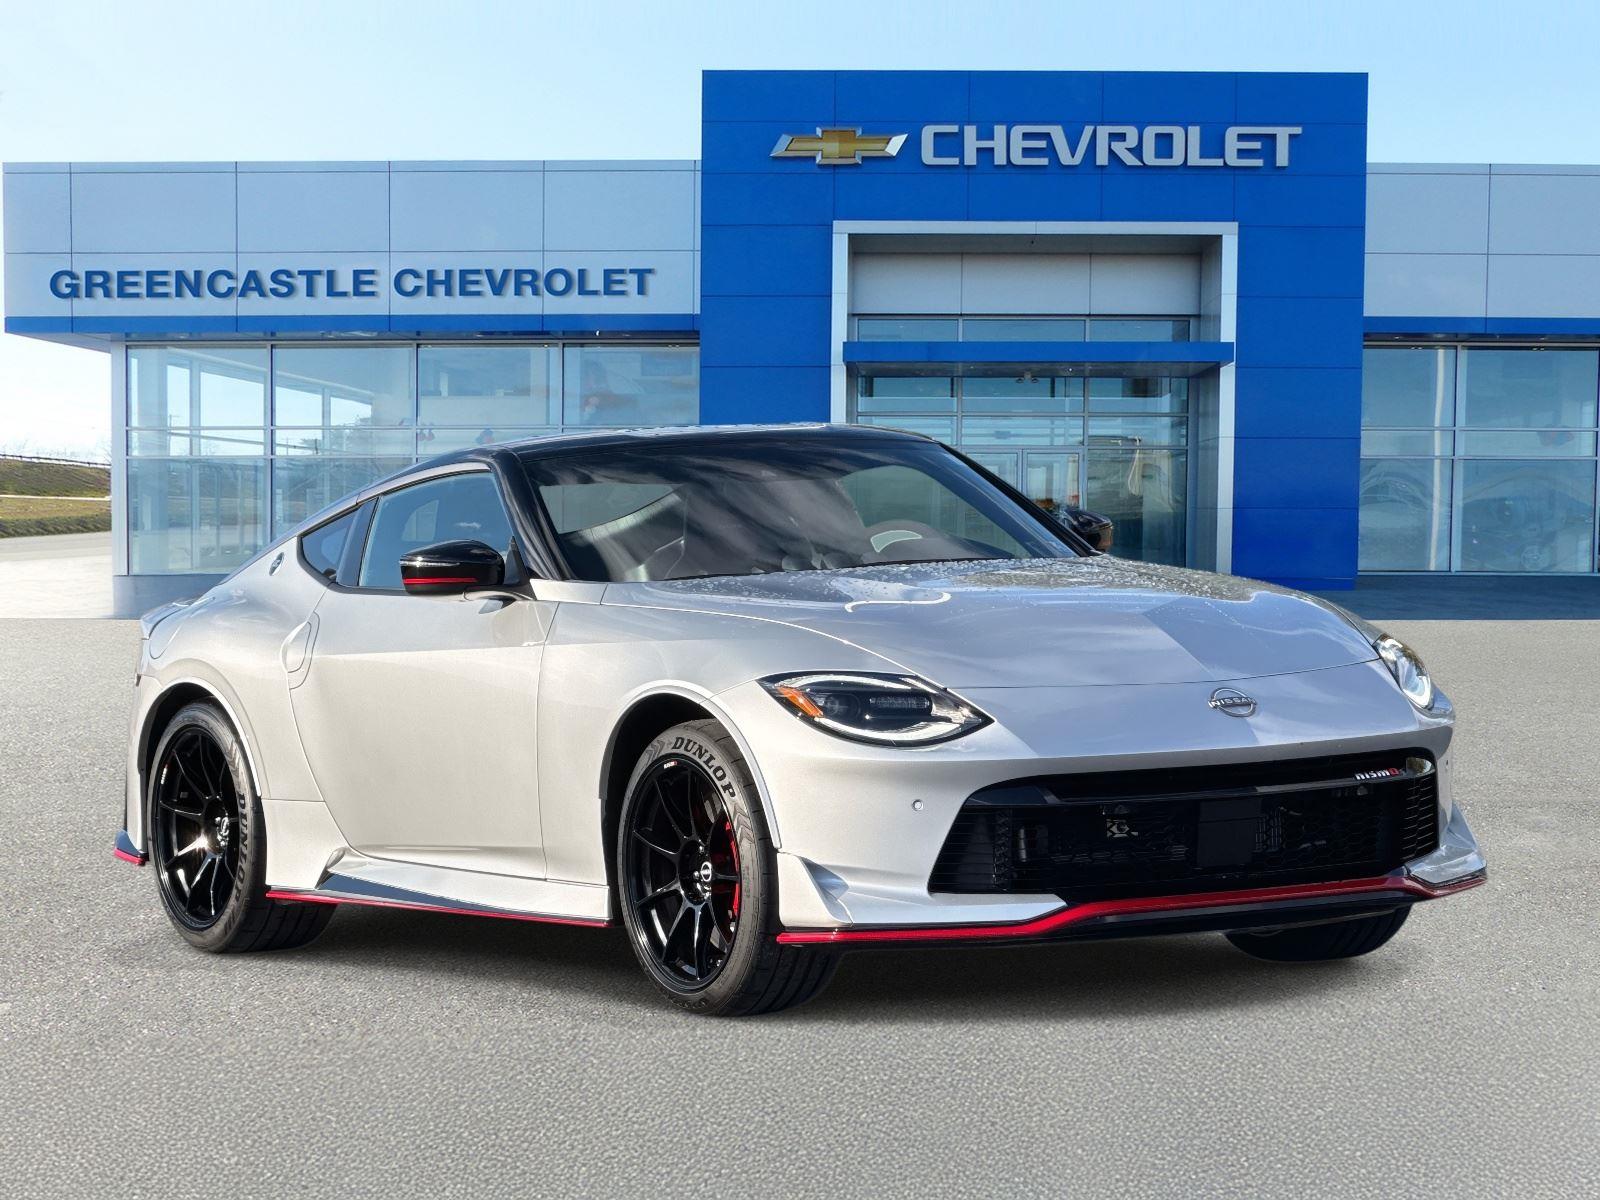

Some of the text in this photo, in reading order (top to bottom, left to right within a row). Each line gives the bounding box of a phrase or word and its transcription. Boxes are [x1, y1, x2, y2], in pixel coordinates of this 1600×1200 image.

[921, 125, 1302, 167] CHEVROLET
[49, 268, 655, 299] GREENCASTLE CHEVROLET
[1207, 697, 1256, 708] NISSAN
[671, 736, 736, 798] DUNLOP
[234, 793, 248, 901] DUNLOP
